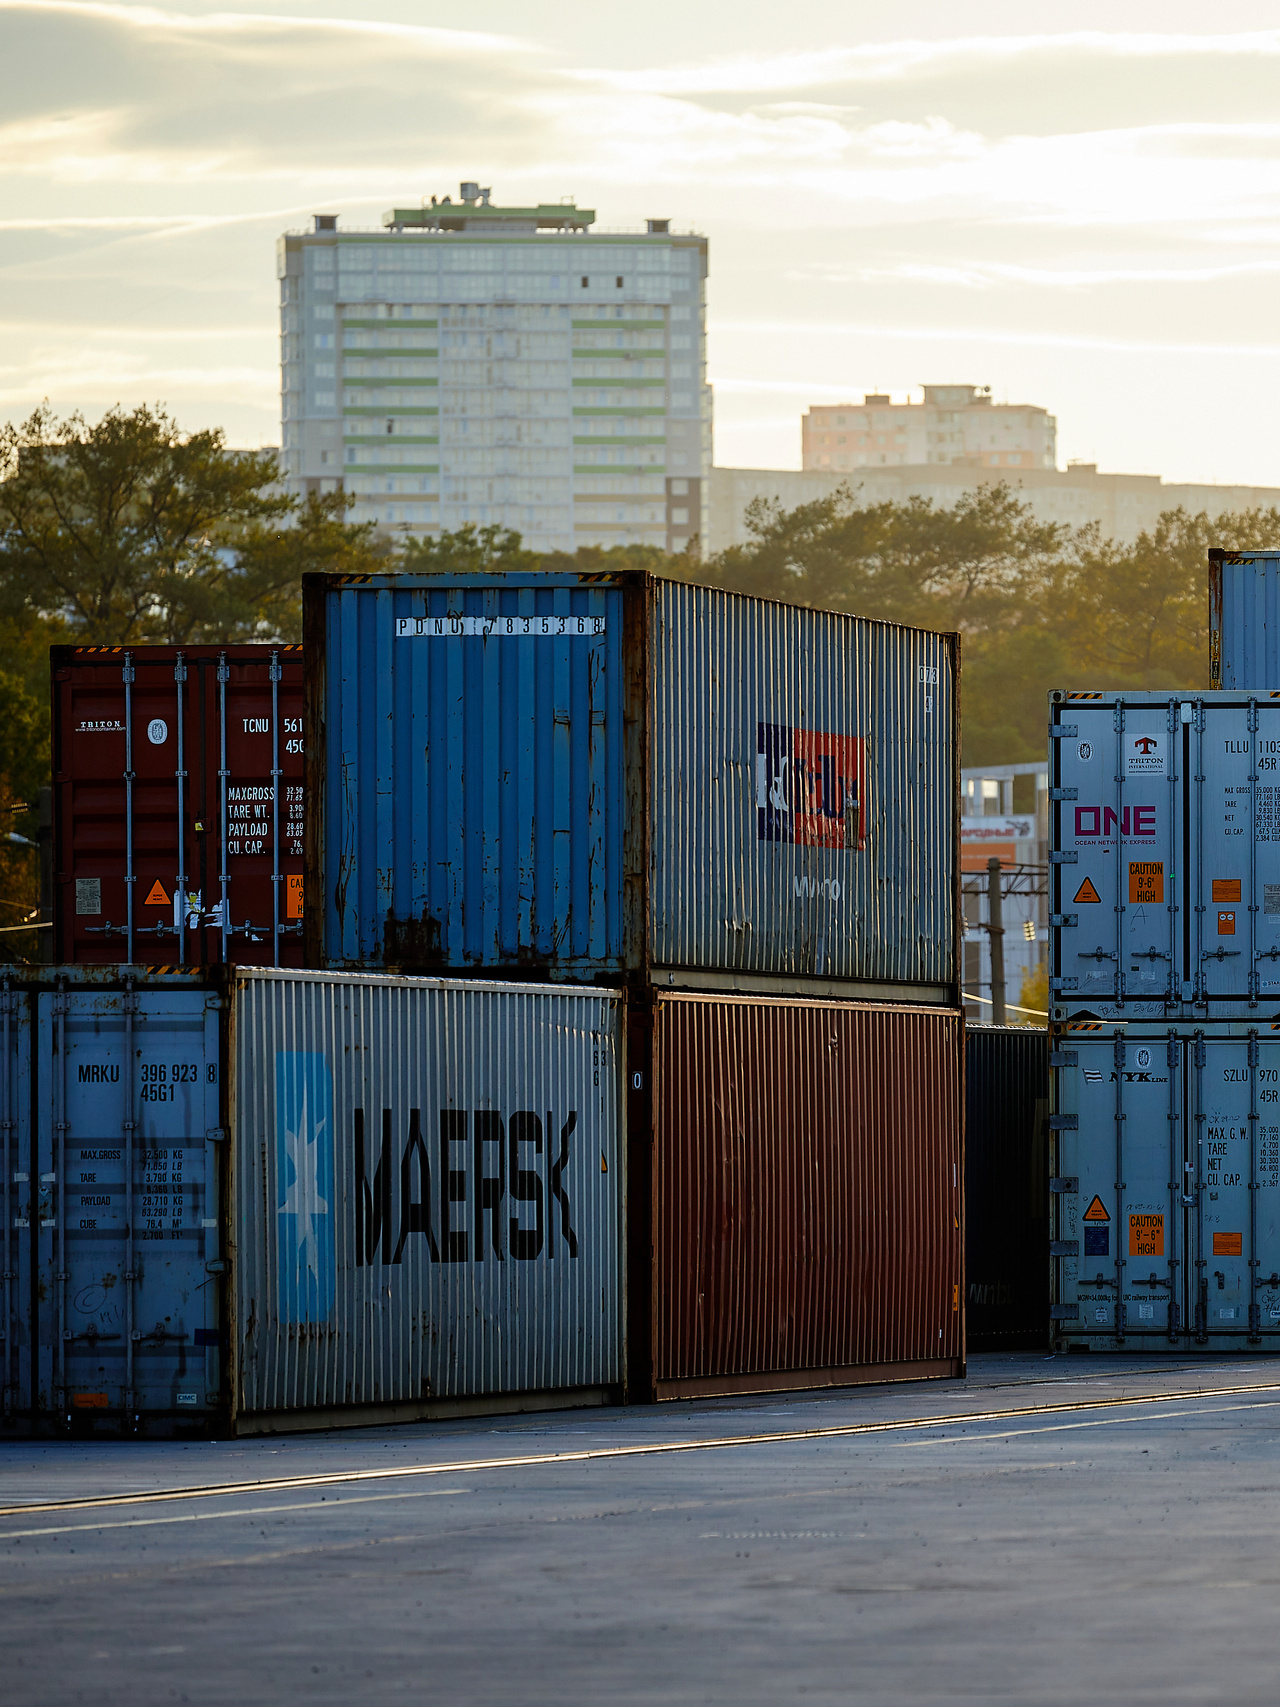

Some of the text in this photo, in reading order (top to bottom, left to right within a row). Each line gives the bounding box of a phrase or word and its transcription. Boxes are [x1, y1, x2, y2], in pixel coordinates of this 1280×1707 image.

[80, 720, 121, 729] TRITON
[242, 718, 269, 733] TCNU
[1224, 740, 1249, 753] TLLU
[228, 804, 270, 819] TARE WT.
[1074, 806, 1156, 836] ONE
[228, 822, 268, 837] PAYLOAD
[1129, 863, 1163, 875] CAUTION
[1136, 890, 1156, 902] HIGH
[78, 1064, 120, 1083] MRKU
[141, 1064, 166, 1082] 396
[172, 1064, 198, 1082] 923
[1109, 1071, 1152, 1082] NYK
[1223, 1069, 1248, 1082] SZLU
[140, 1083, 175, 1102] 45G1
[172, 1150, 183, 1159] KG
[1207, 1142, 1228, 1155] TARE
[172, 1162, 182, 1170] LB
[1207, 1158, 1222, 1170] NET
[80, 1173, 97, 1182] TARE
[171, 1173, 182, 1182] KG
[172, 1185, 183, 1193] LB
[354, 1107, 579, 1268] MAERSK
[80, 1196, 111, 1205] PAYLOAD
[172, 1196, 183, 1205] KG
[172, 1207, 182, 1216] LB
[79, 1219, 97, 1229] CUBE
[1130, 1215, 1163, 1228] CAUTION
[1137, 1243, 1156, 1254] HIGH
